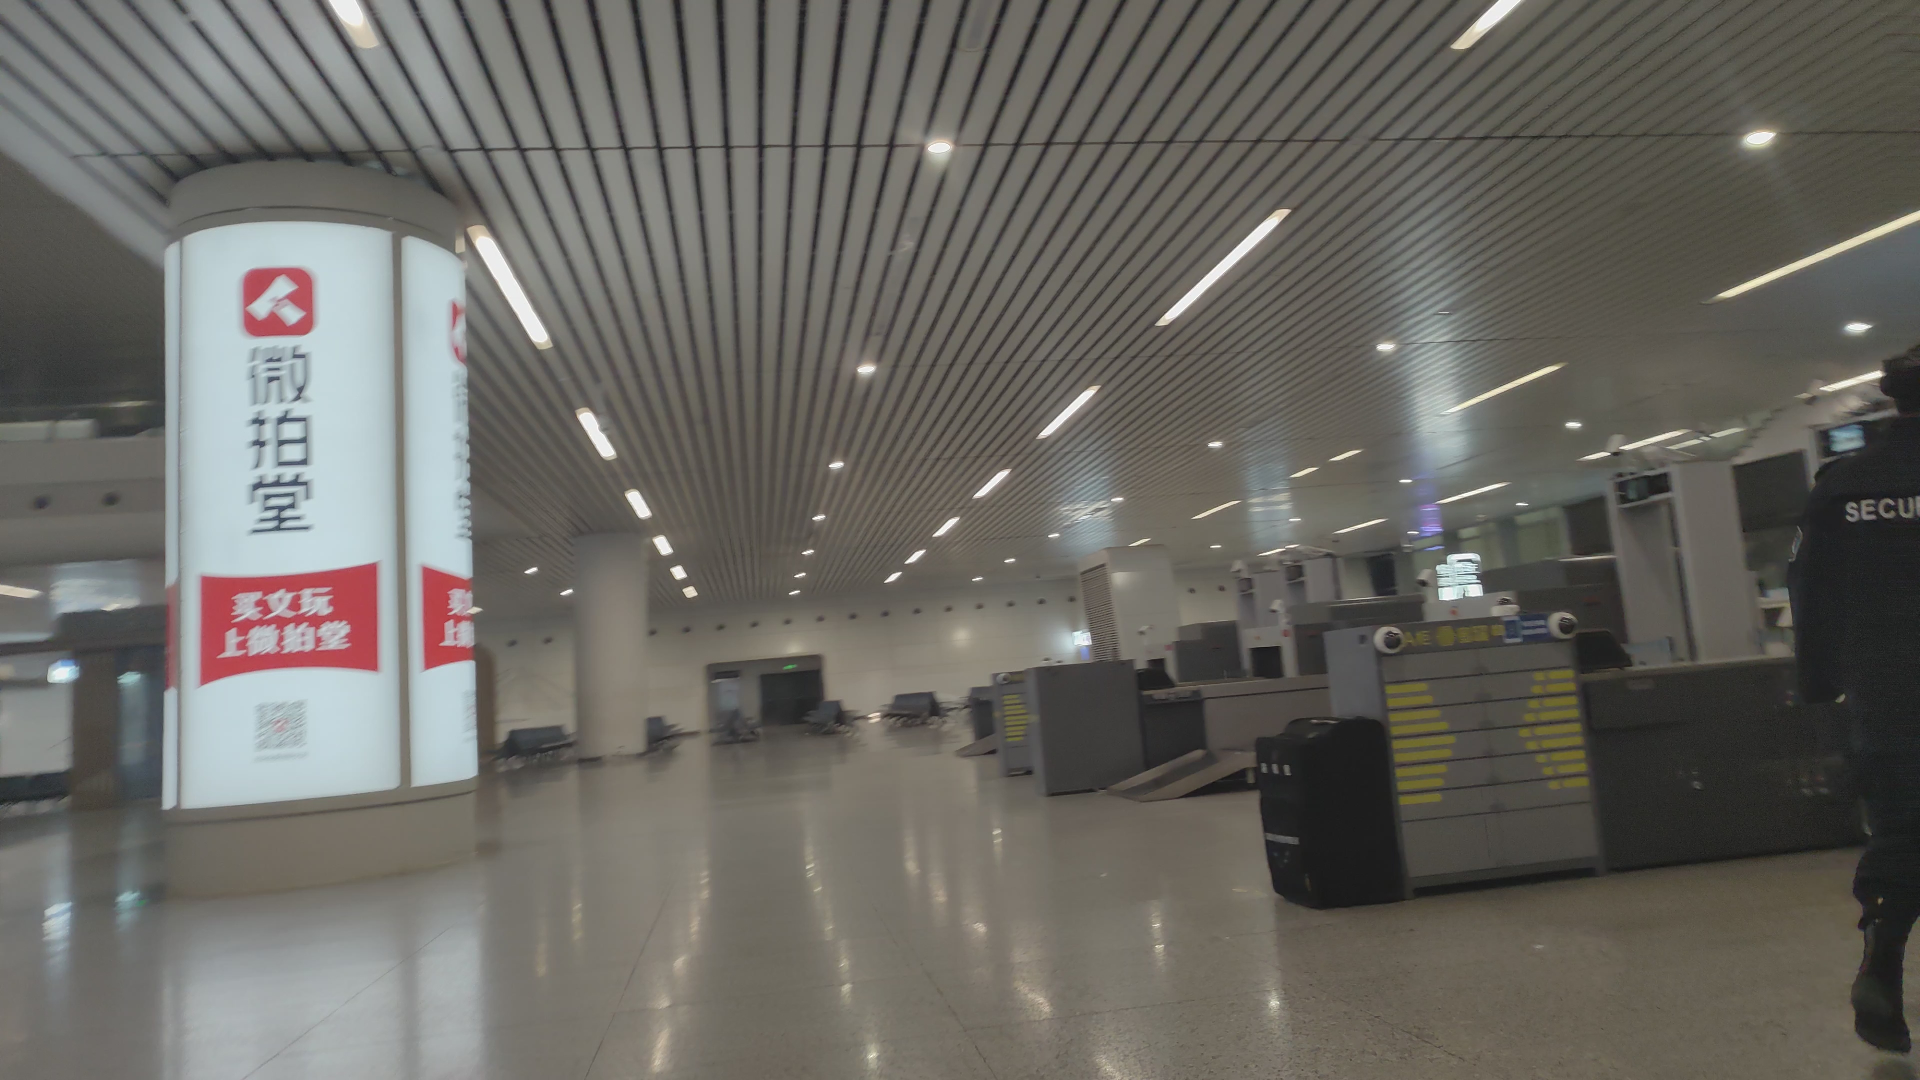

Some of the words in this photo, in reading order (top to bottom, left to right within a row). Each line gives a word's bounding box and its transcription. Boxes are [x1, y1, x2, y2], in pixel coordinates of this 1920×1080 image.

[248, 346, 313, 534] 微拍堂
[230, 587, 334, 623] 买文玩
[216, 620, 352, 659] 上微拍堂
